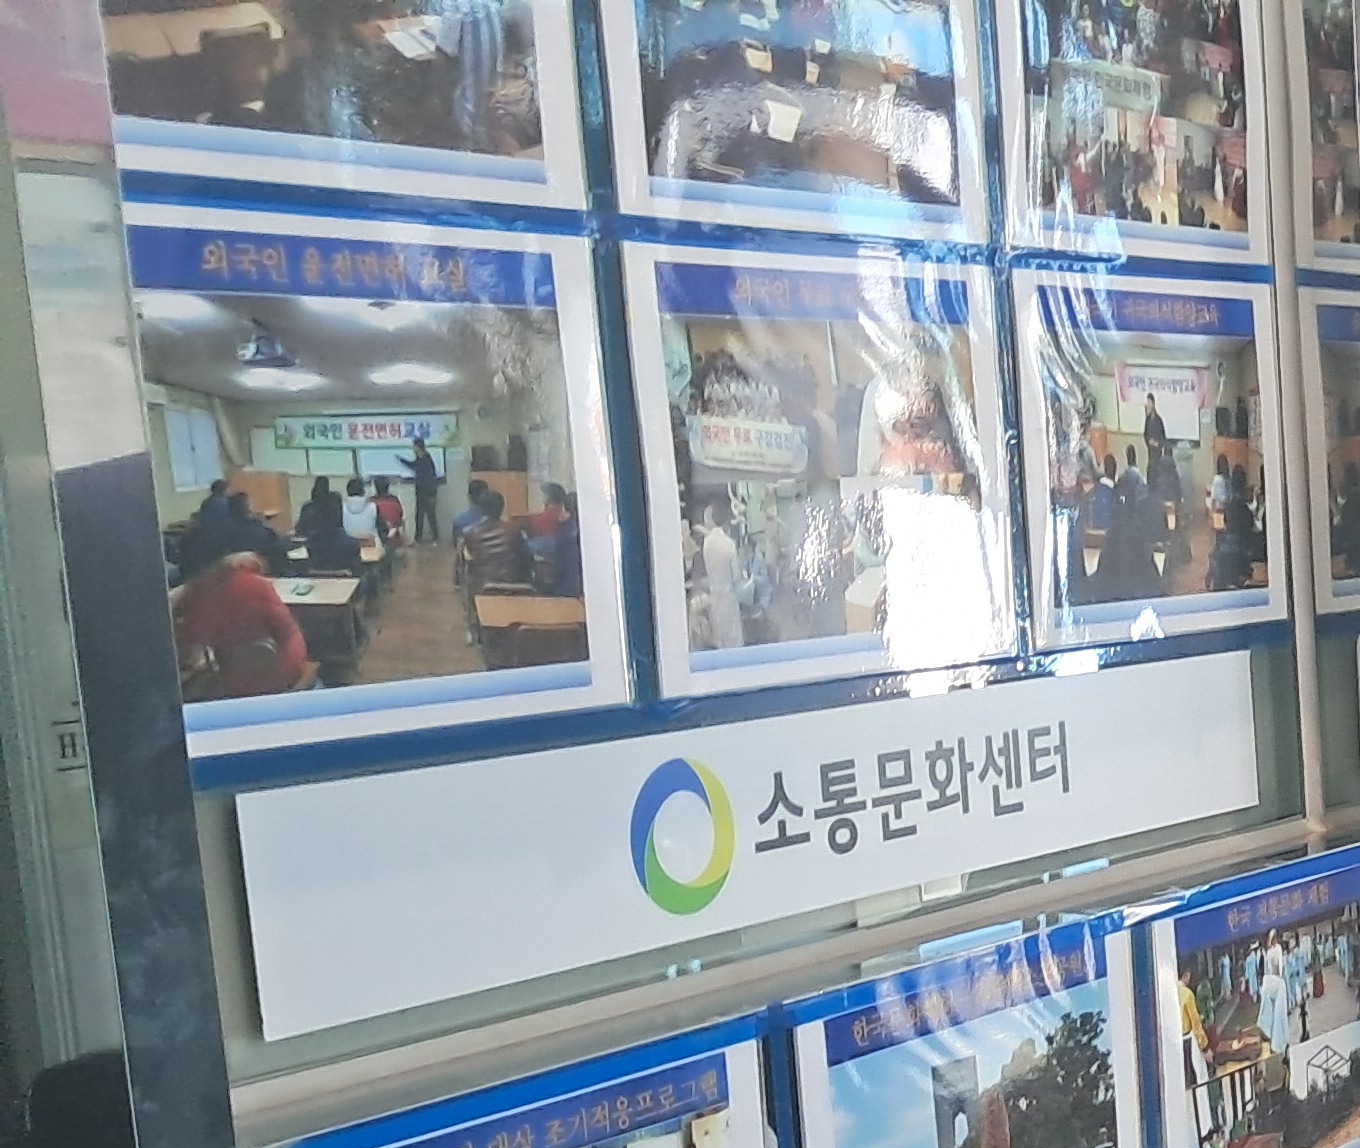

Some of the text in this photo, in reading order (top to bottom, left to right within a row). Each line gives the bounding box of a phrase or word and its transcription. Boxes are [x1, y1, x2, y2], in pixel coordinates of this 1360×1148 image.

[201, 240, 290, 282] 외국인
[303, 421, 342, 440] 외국인
[754, 720, 1069, 855] 소통문화센터
[543, 1069, 719, 1146] 조기적응프로그램
